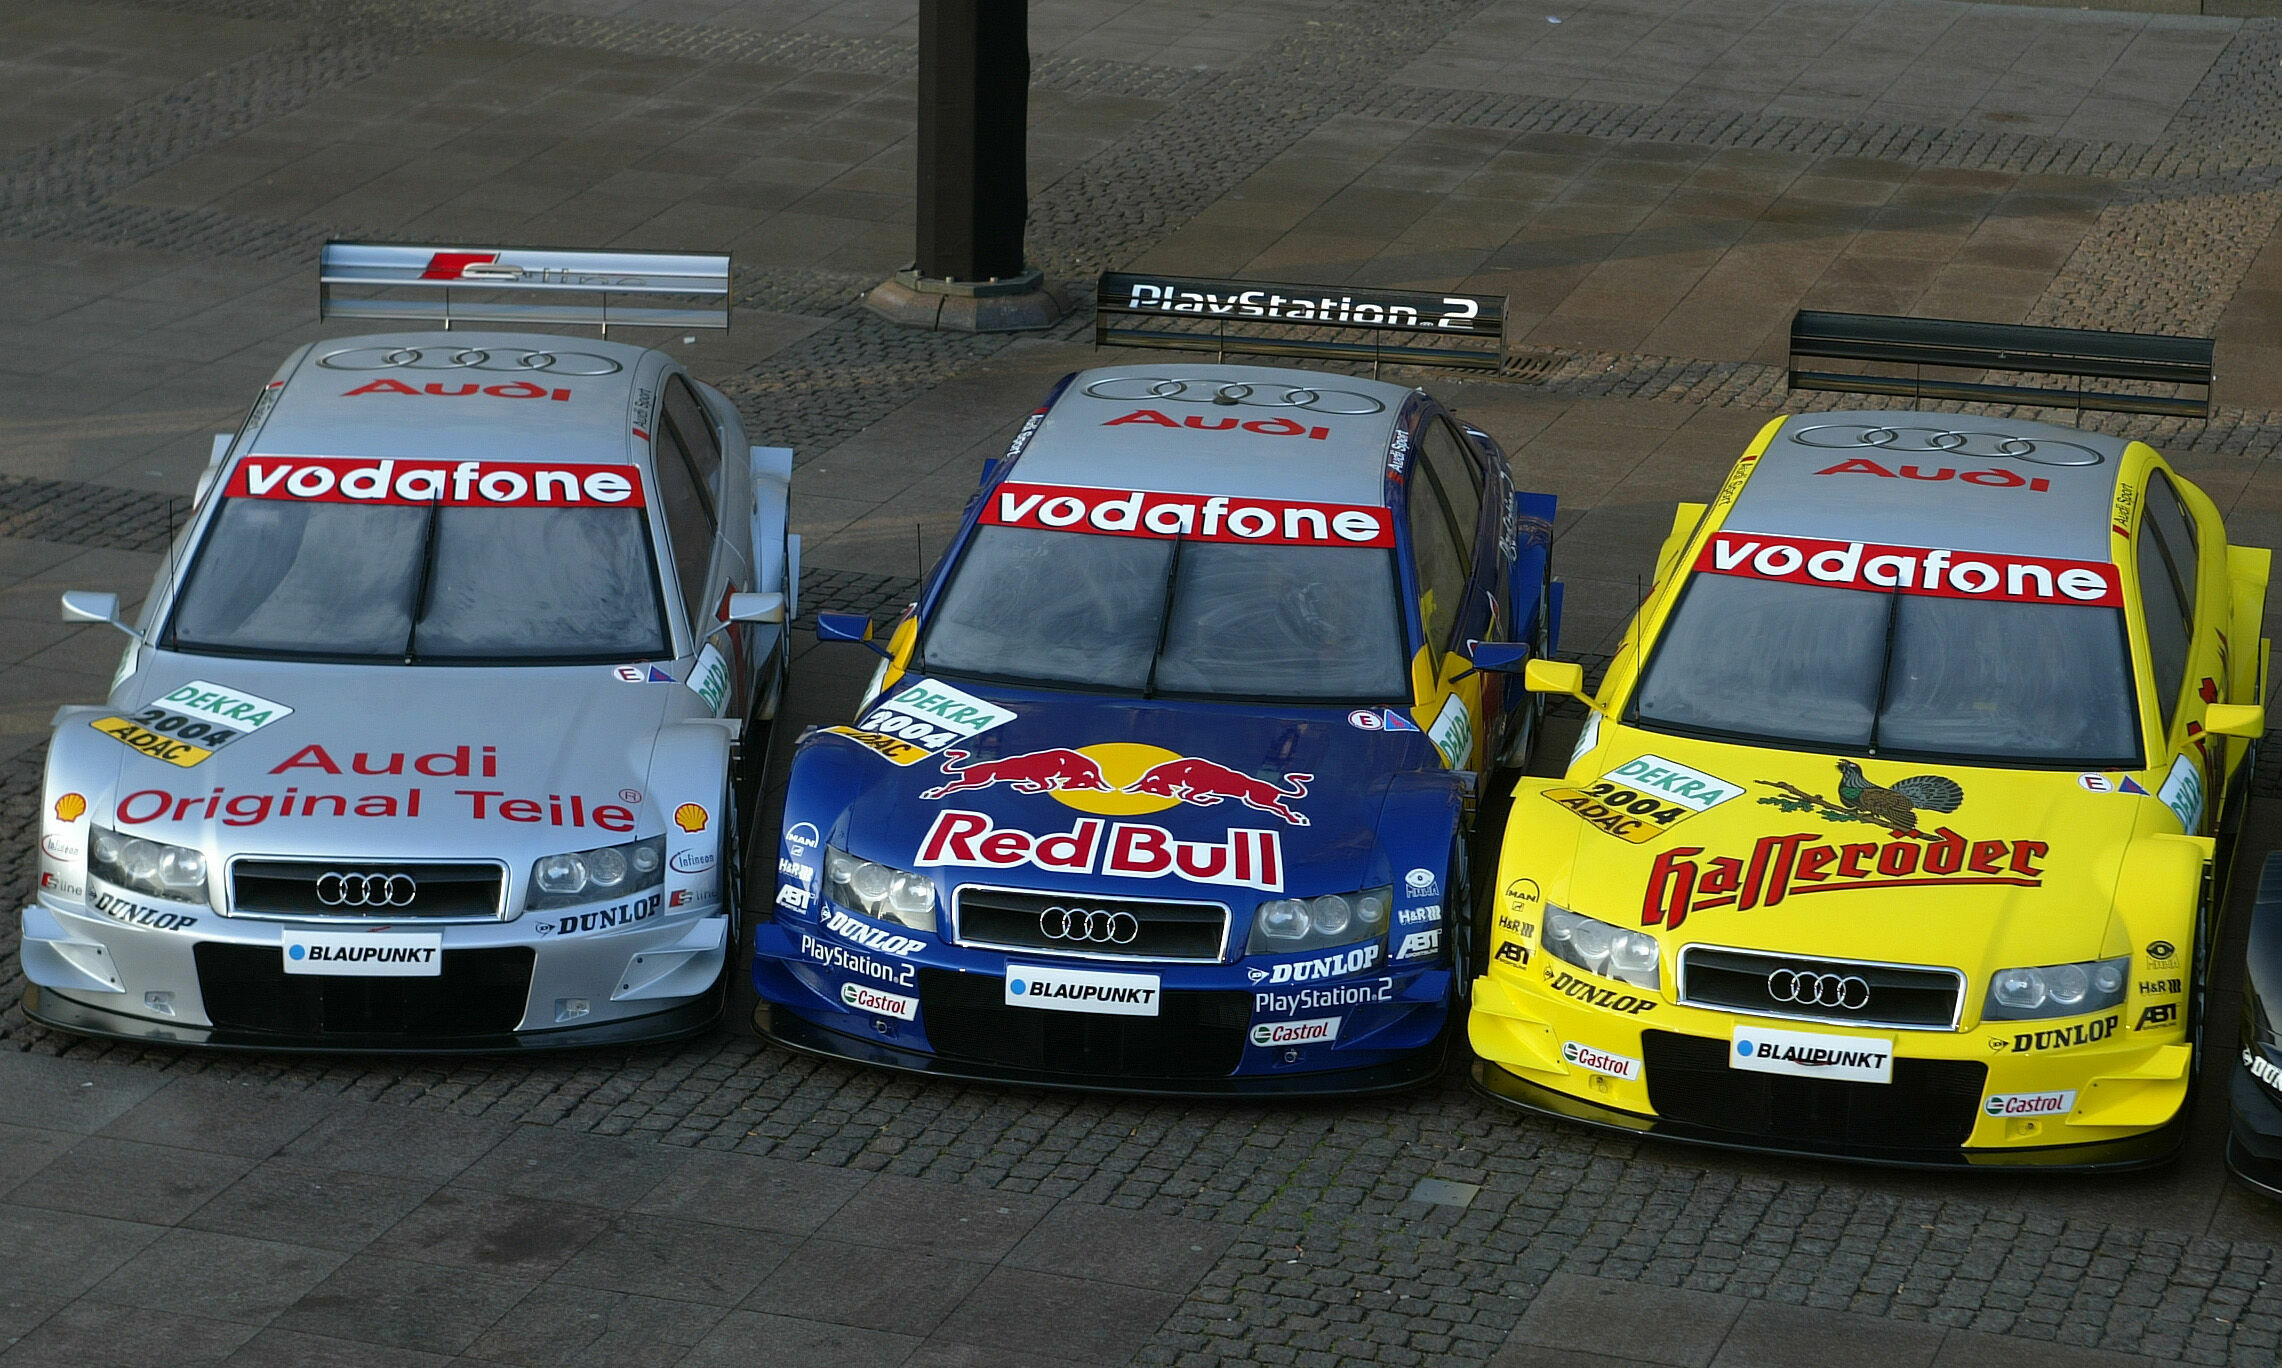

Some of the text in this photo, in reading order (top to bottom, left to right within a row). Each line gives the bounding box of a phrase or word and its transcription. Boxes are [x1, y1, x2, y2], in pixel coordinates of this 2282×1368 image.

[340, 378, 571, 401] Audi
[1100, 409, 1330, 440] Audi
[247, 458, 632, 502] vodafone
[1812, 457, 2050, 493] Audi
[1000, 491, 1381, 542] vodafone
[1714, 539, 2109, 600] vodafone
[164, 686, 273, 727] DEKRA
[893, 687, 996, 730] DEKRA
[108, 726, 192, 760] ADAC
[129, 710, 239, 747] 2004
[860, 711, 959, 748] 2004
[268, 744, 497, 777] Audi
[1613, 760, 1725, 806] DEKRA
[115, 787, 421, 827] Original
[1560, 797, 1643, 836] ADAC
[1579, 783, 1689, 825] 2004
[47, 839, 79, 856] Ineon
[679, 852, 715, 868] Infineon
[917, 811, 1281, 890] Red Bull
[95, 892, 199, 931] DUNLOP
[556, 892, 661, 936] DUNLOP
[1506, 889, 1537, 902] MAN
[826, 911, 928, 956] DUNLOP
[1396, 929, 1440, 960] ABT
[308, 945, 436, 963] BLAUPUNKT
[1269, 944, 1379, 984] DUNLOP
[857, 990, 907, 1015] Castrol
[1029, 981, 1156, 1005] BLAUPUNKT
[1551, 972, 1659, 1015] DUNLOP
[1272, 1021, 1329, 1042] Castrol
[2011, 1015, 2119, 1053] DUNLOP
[2134, 1003, 2177, 1031] ABT
[1578, 1048, 1630, 1076] Castrol
[1756, 1042, 1888, 1069] BLAUPUNKT
[2005, 1094, 2064, 1114] Castrol
